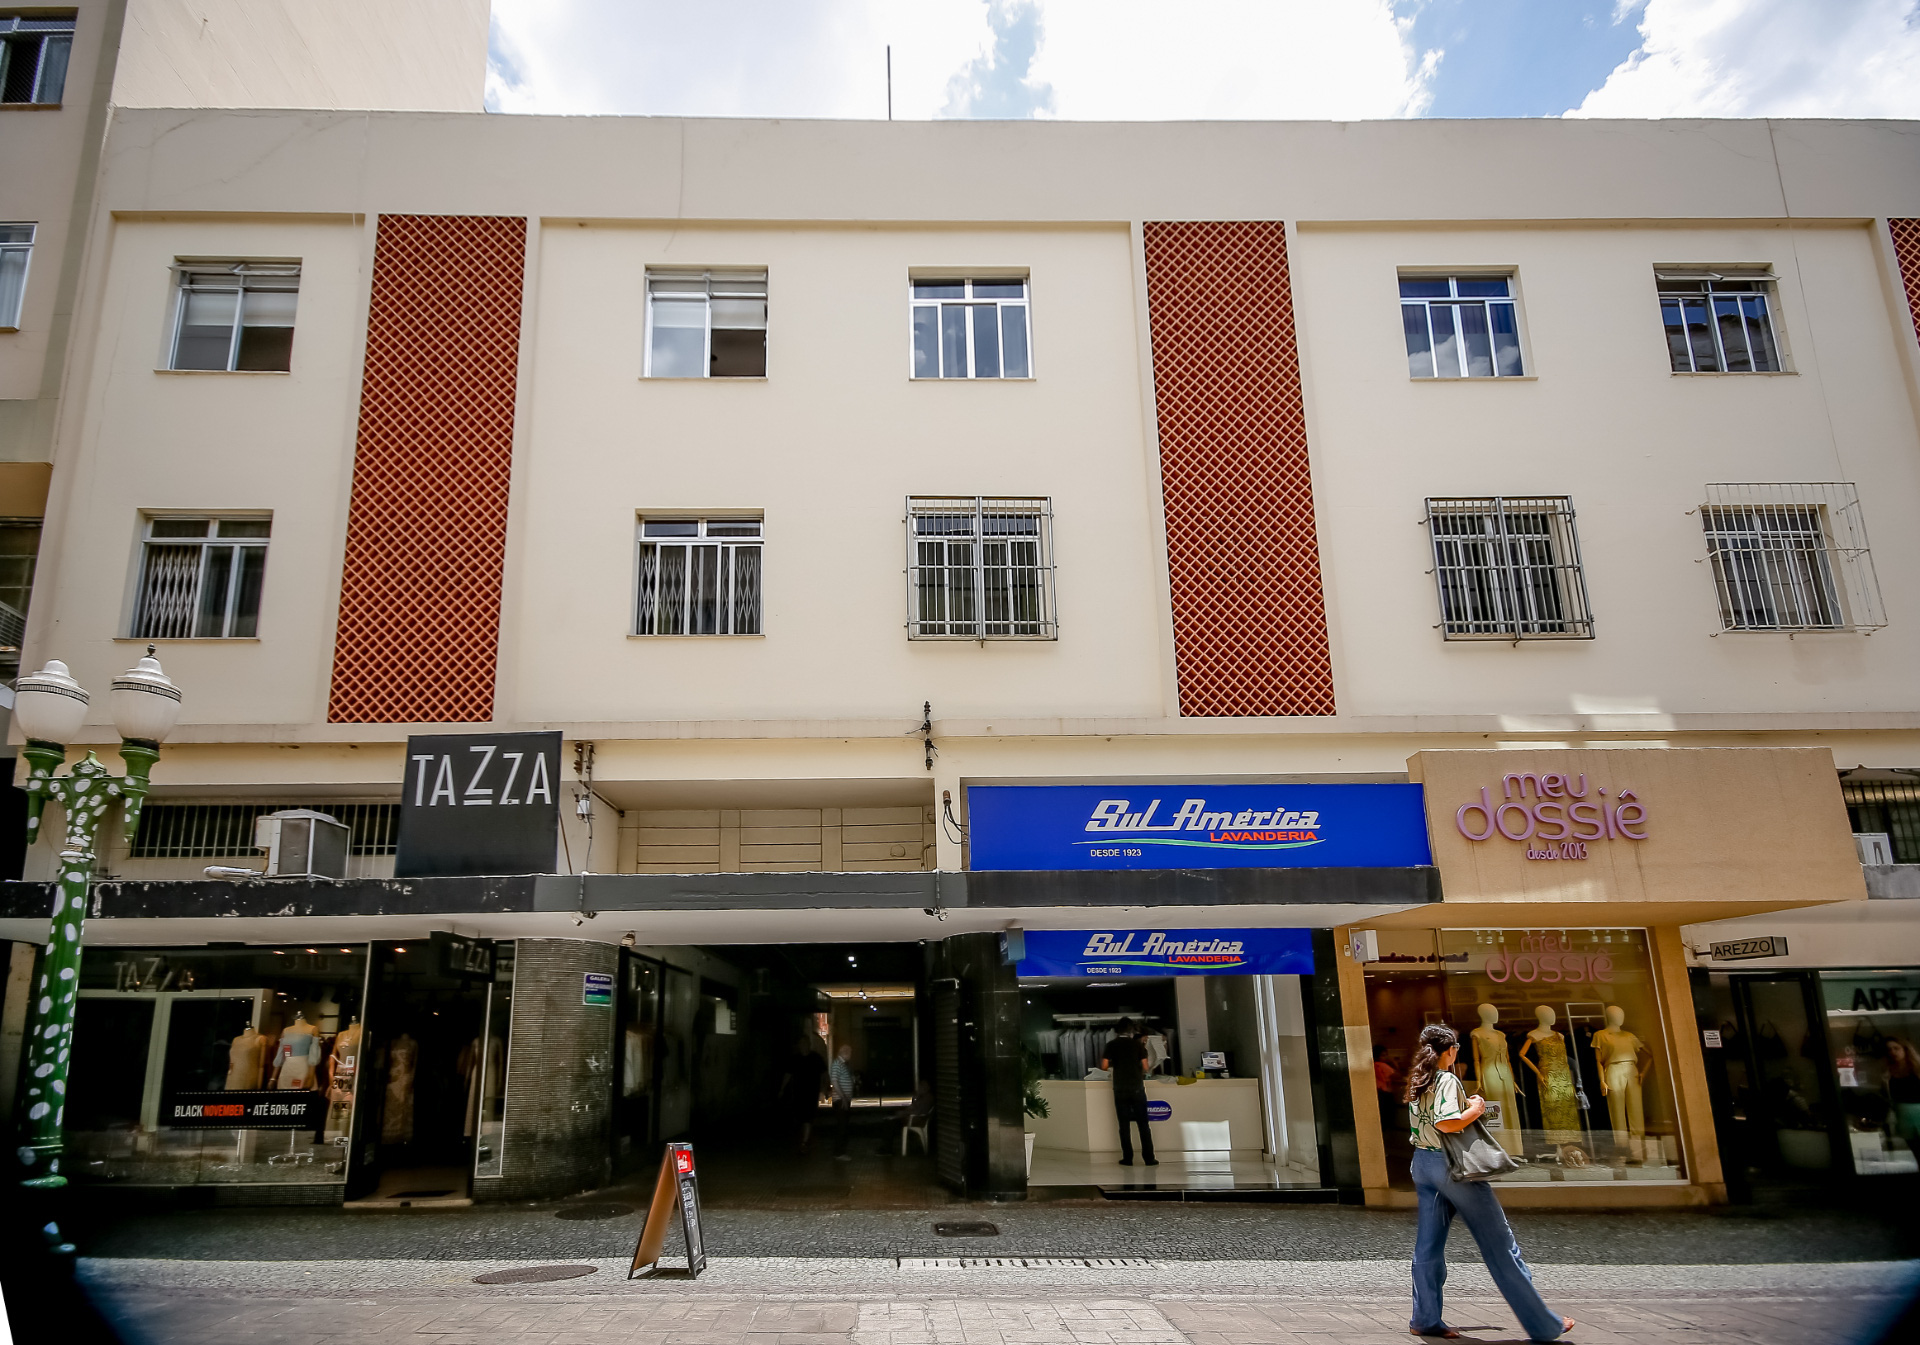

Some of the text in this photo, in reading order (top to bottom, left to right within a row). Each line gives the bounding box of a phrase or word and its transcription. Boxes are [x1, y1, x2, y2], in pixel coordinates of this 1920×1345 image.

[412, 746, 552, 806] TAZZA
[1503, 773, 1588, 798] meu
[1085, 798, 1322, 832] Sul América
[1456, 786, 1649, 840] dossiê
[1210, 831, 1317, 842] LAVANDERIA
[1090, 848, 1142, 857] DESDE 1923
[1526, 842, 1588, 860] desde 2013
[1083, 932, 1244, 956] Sul América
[1520, 935, 1573, 952] meu
[1714, 940, 1771, 958] AREZZO
[174, 1102, 307, 1117] BLACK NOVEMBER ATÉ 50% OFF
